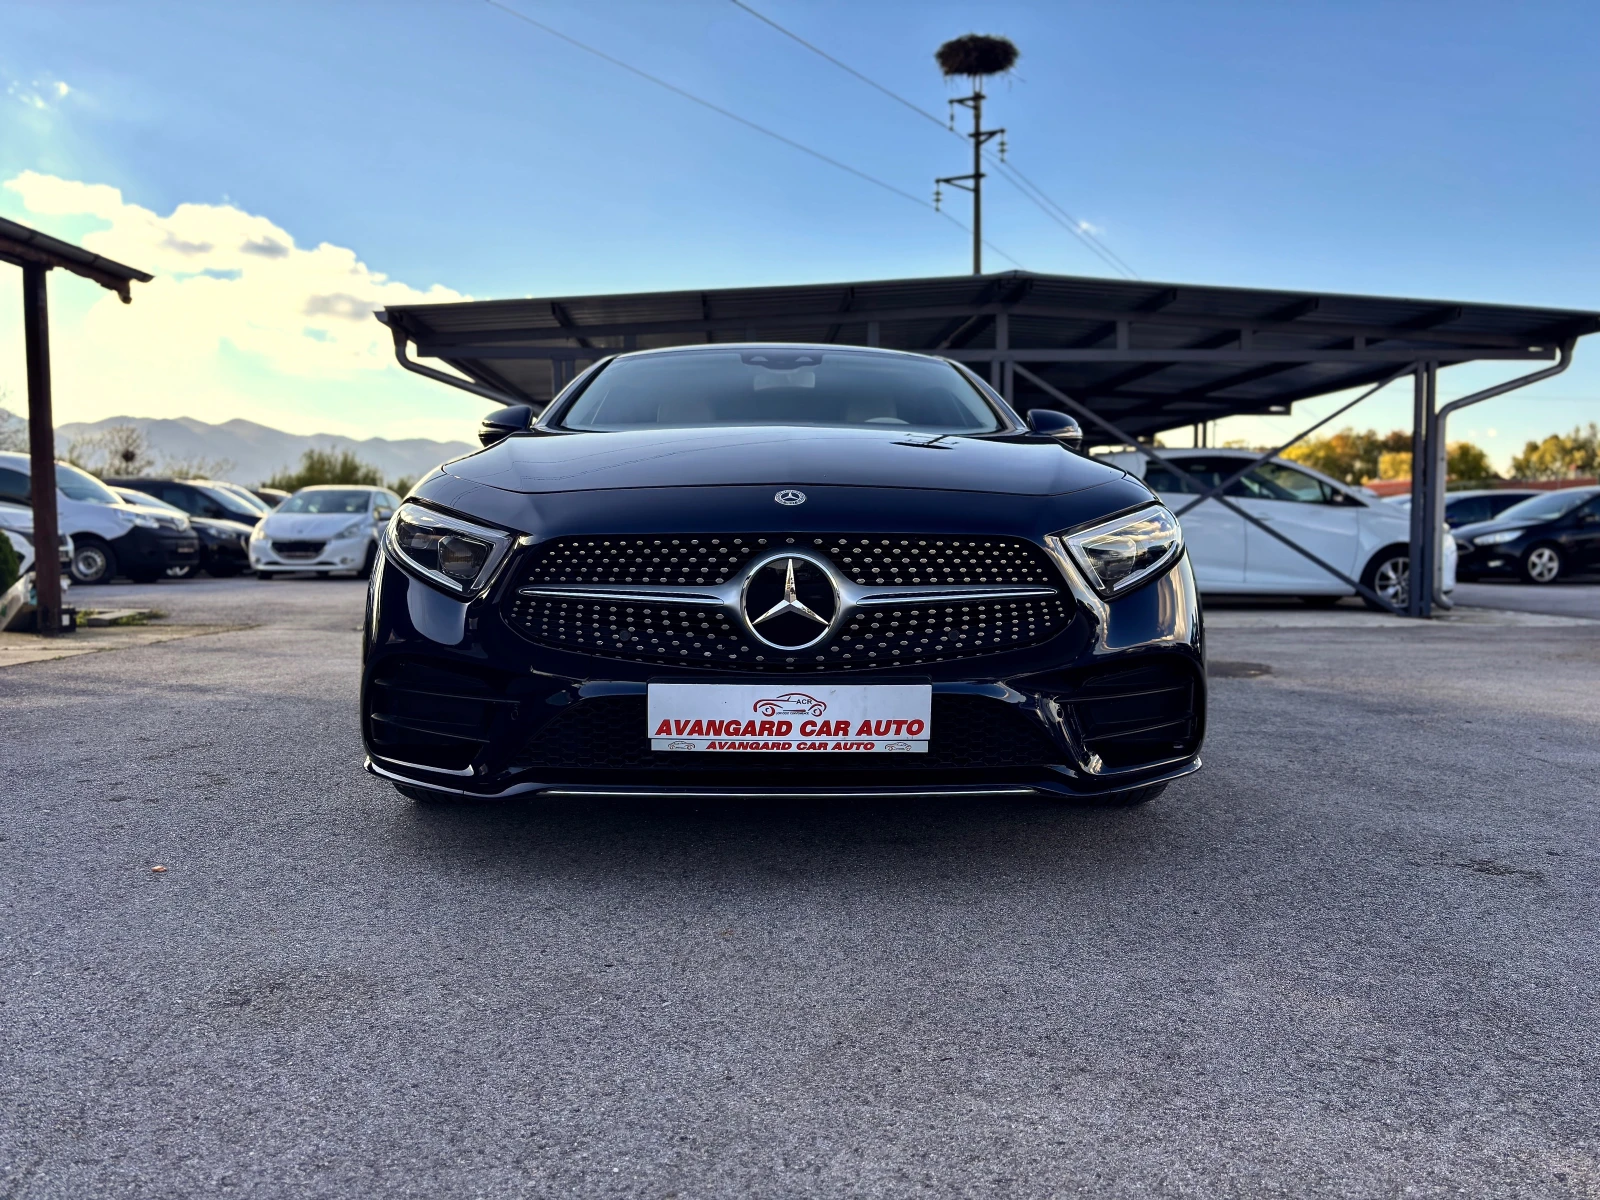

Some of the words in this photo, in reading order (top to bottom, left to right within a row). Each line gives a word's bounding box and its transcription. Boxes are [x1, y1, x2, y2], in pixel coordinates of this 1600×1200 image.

[654, 719, 793, 737] AVANGARD
[799, 719, 851, 737] CAR
[855, 718, 925, 737] AUTO
[705, 741, 793, 751] AVANGARD
[796, 742, 829, 751] CAR
[831, 742, 876, 751] AUTO
